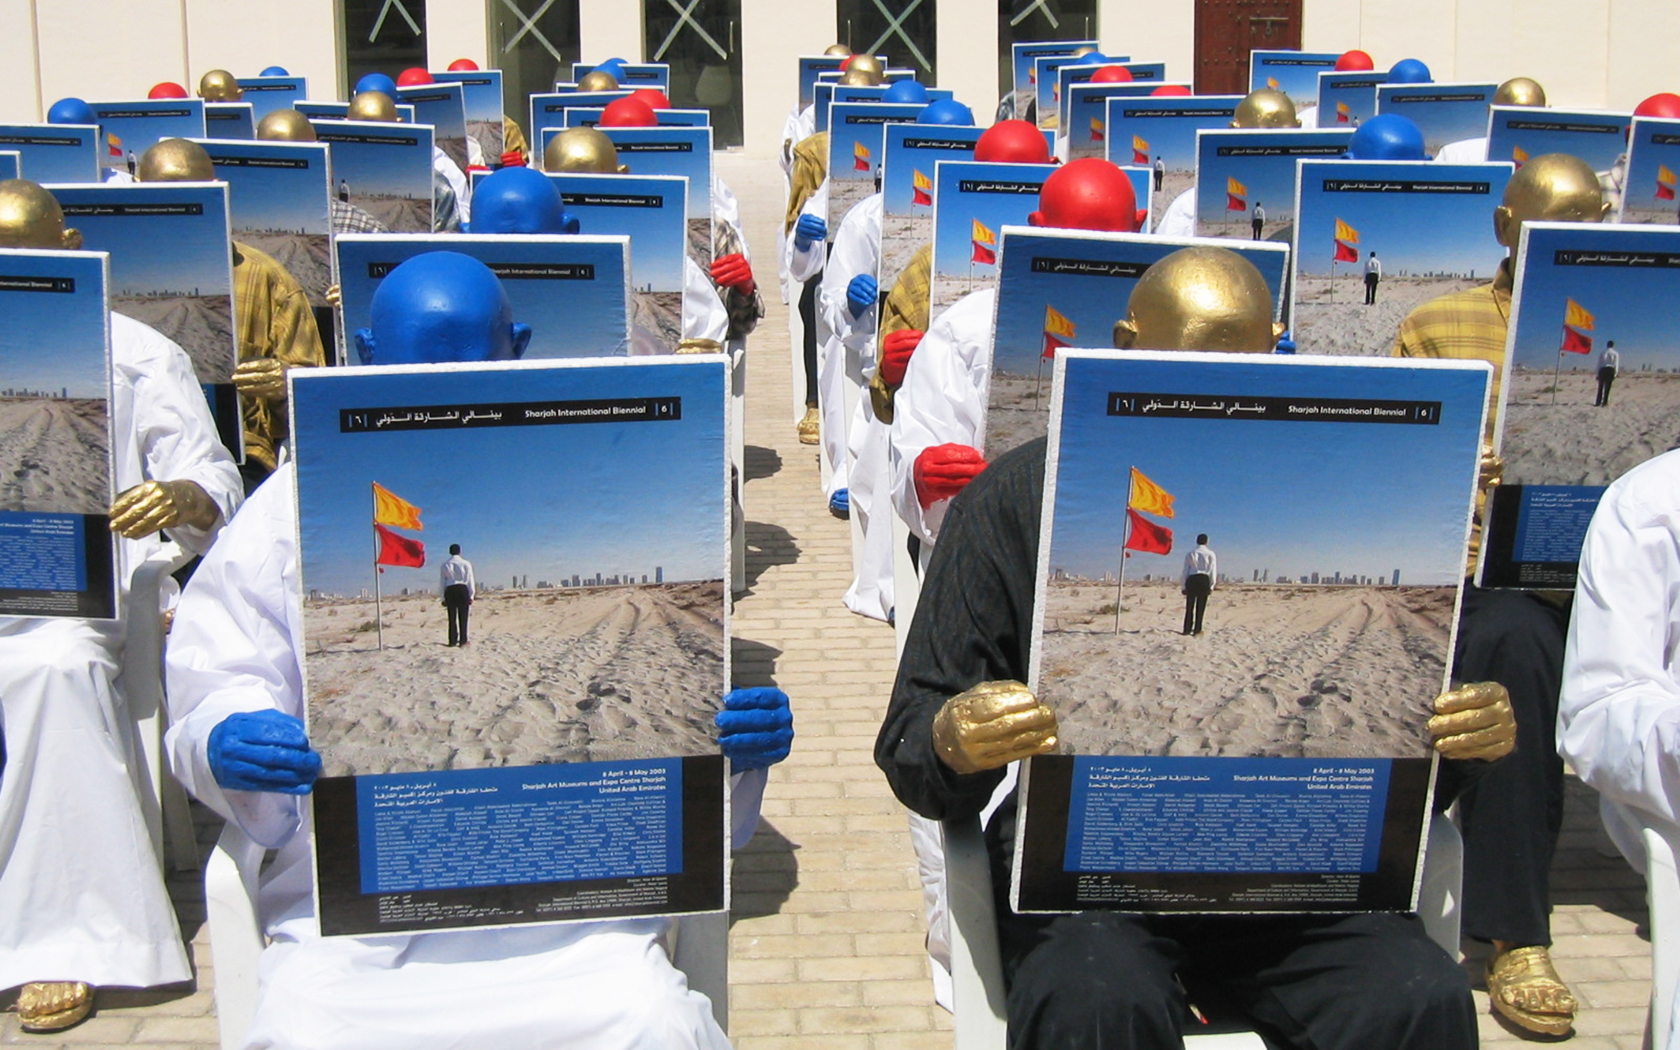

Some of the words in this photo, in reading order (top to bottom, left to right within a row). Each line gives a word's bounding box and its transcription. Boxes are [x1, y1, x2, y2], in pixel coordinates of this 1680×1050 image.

[525, 408, 556, 418] Sharjah
[558, 406, 611, 417] International
[612, 406, 646, 415] Biennial
[661, 405, 667, 413] 6
[1180, 400, 1224, 412] الشارقة
[1288, 405, 1319, 416] Sharjah
[1320, 406, 1372, 415] International
[1374, 408, 1406, 416] Biennial
[1421, 409, 1427, 417] 6
[414, 410, 460, 423] الشارقة
